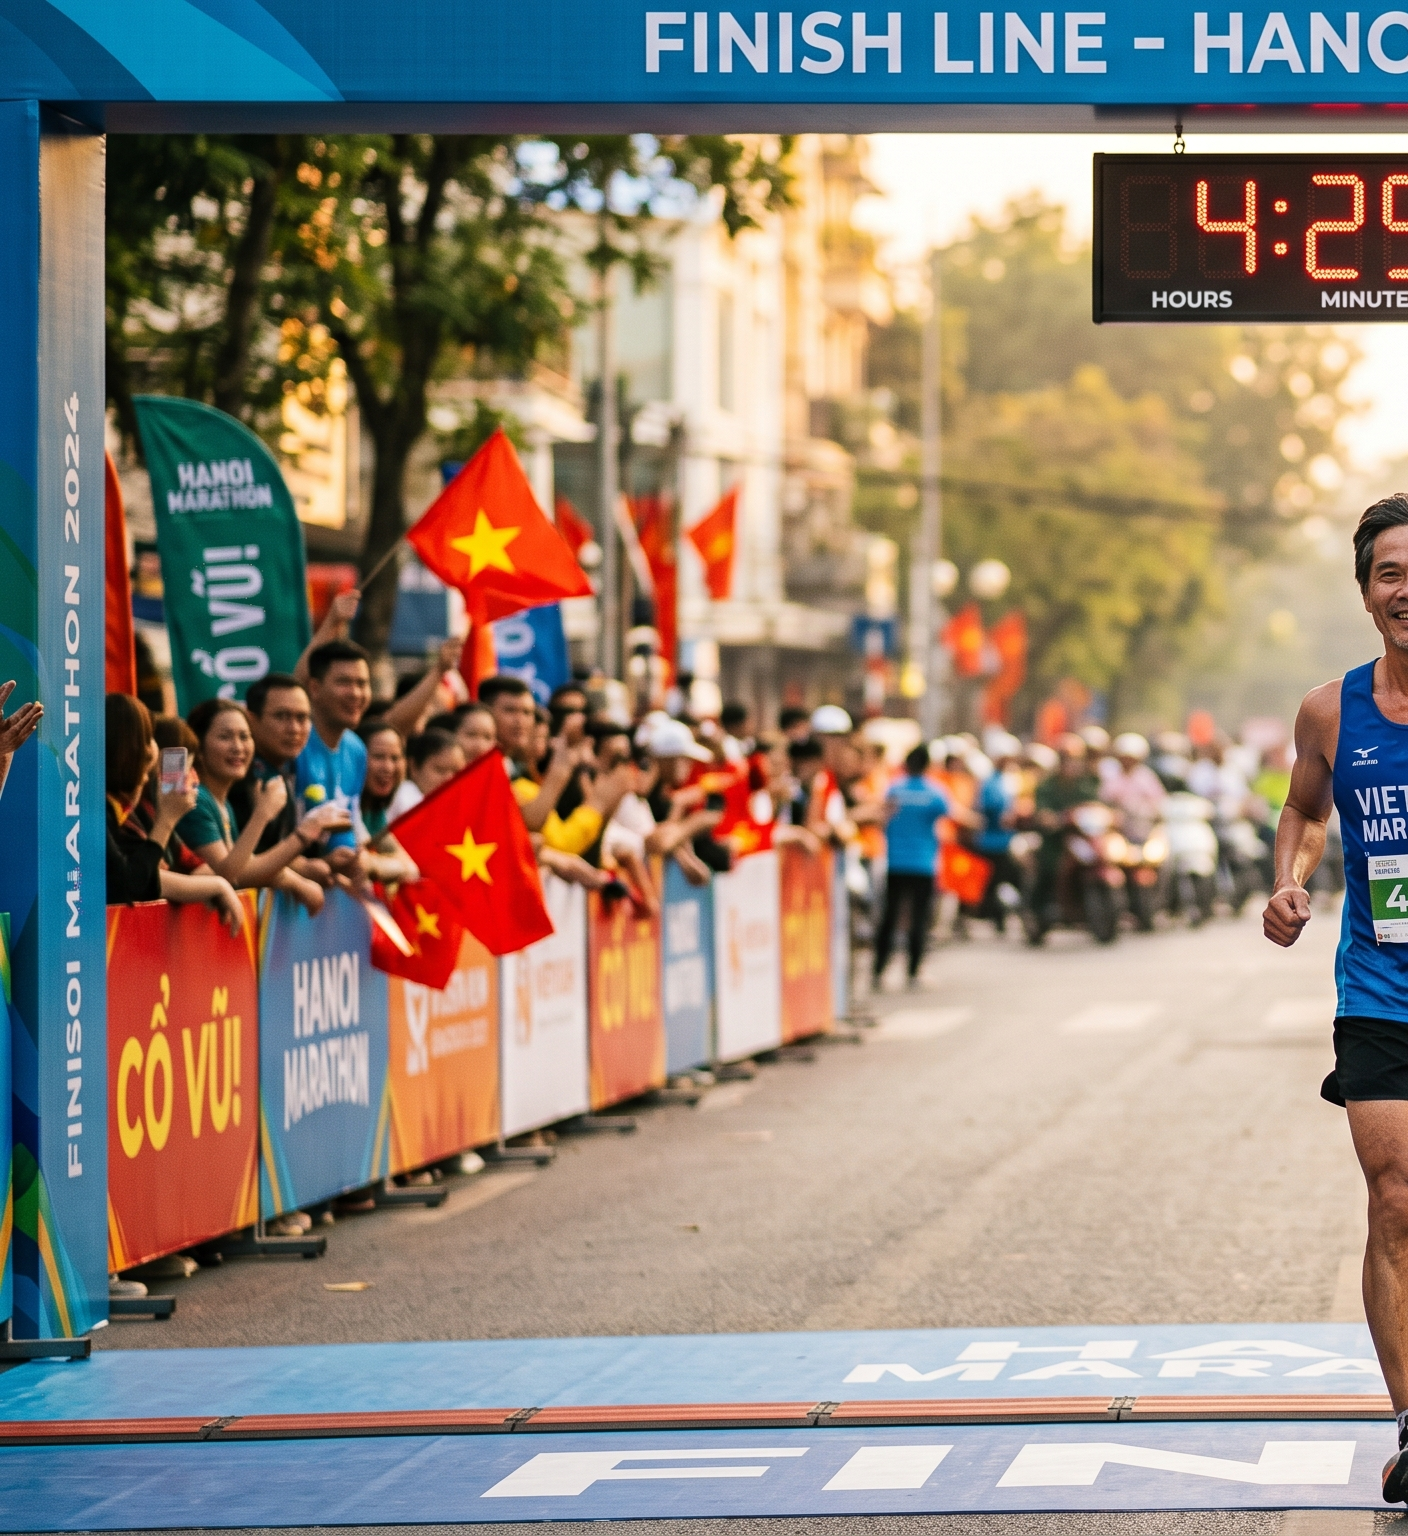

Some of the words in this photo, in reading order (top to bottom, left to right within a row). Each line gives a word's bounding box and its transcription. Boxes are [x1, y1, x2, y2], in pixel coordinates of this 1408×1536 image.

[645, 11, 901, 74] FINISH
[934, 11, 1107, 74] LINE
[1134, 37, 1165, 49] -
[1151, 290, 1233, 309] HOURS
[64, 391, 80, 544] 2024
[167, 484, 273, 514] MARATHON
[177, 458, 254, 490] HANOI
[190, 544, 266, 637] VŨ!
[293, 951, 360, 1039] HANOI
[65, 960, 83, 1178] FINISOI
[116, 973, 174, 1159] CỔ
[181, 985, 242, 1139] VŨ!
[283, 1030, 370, 1132] MARATHON
